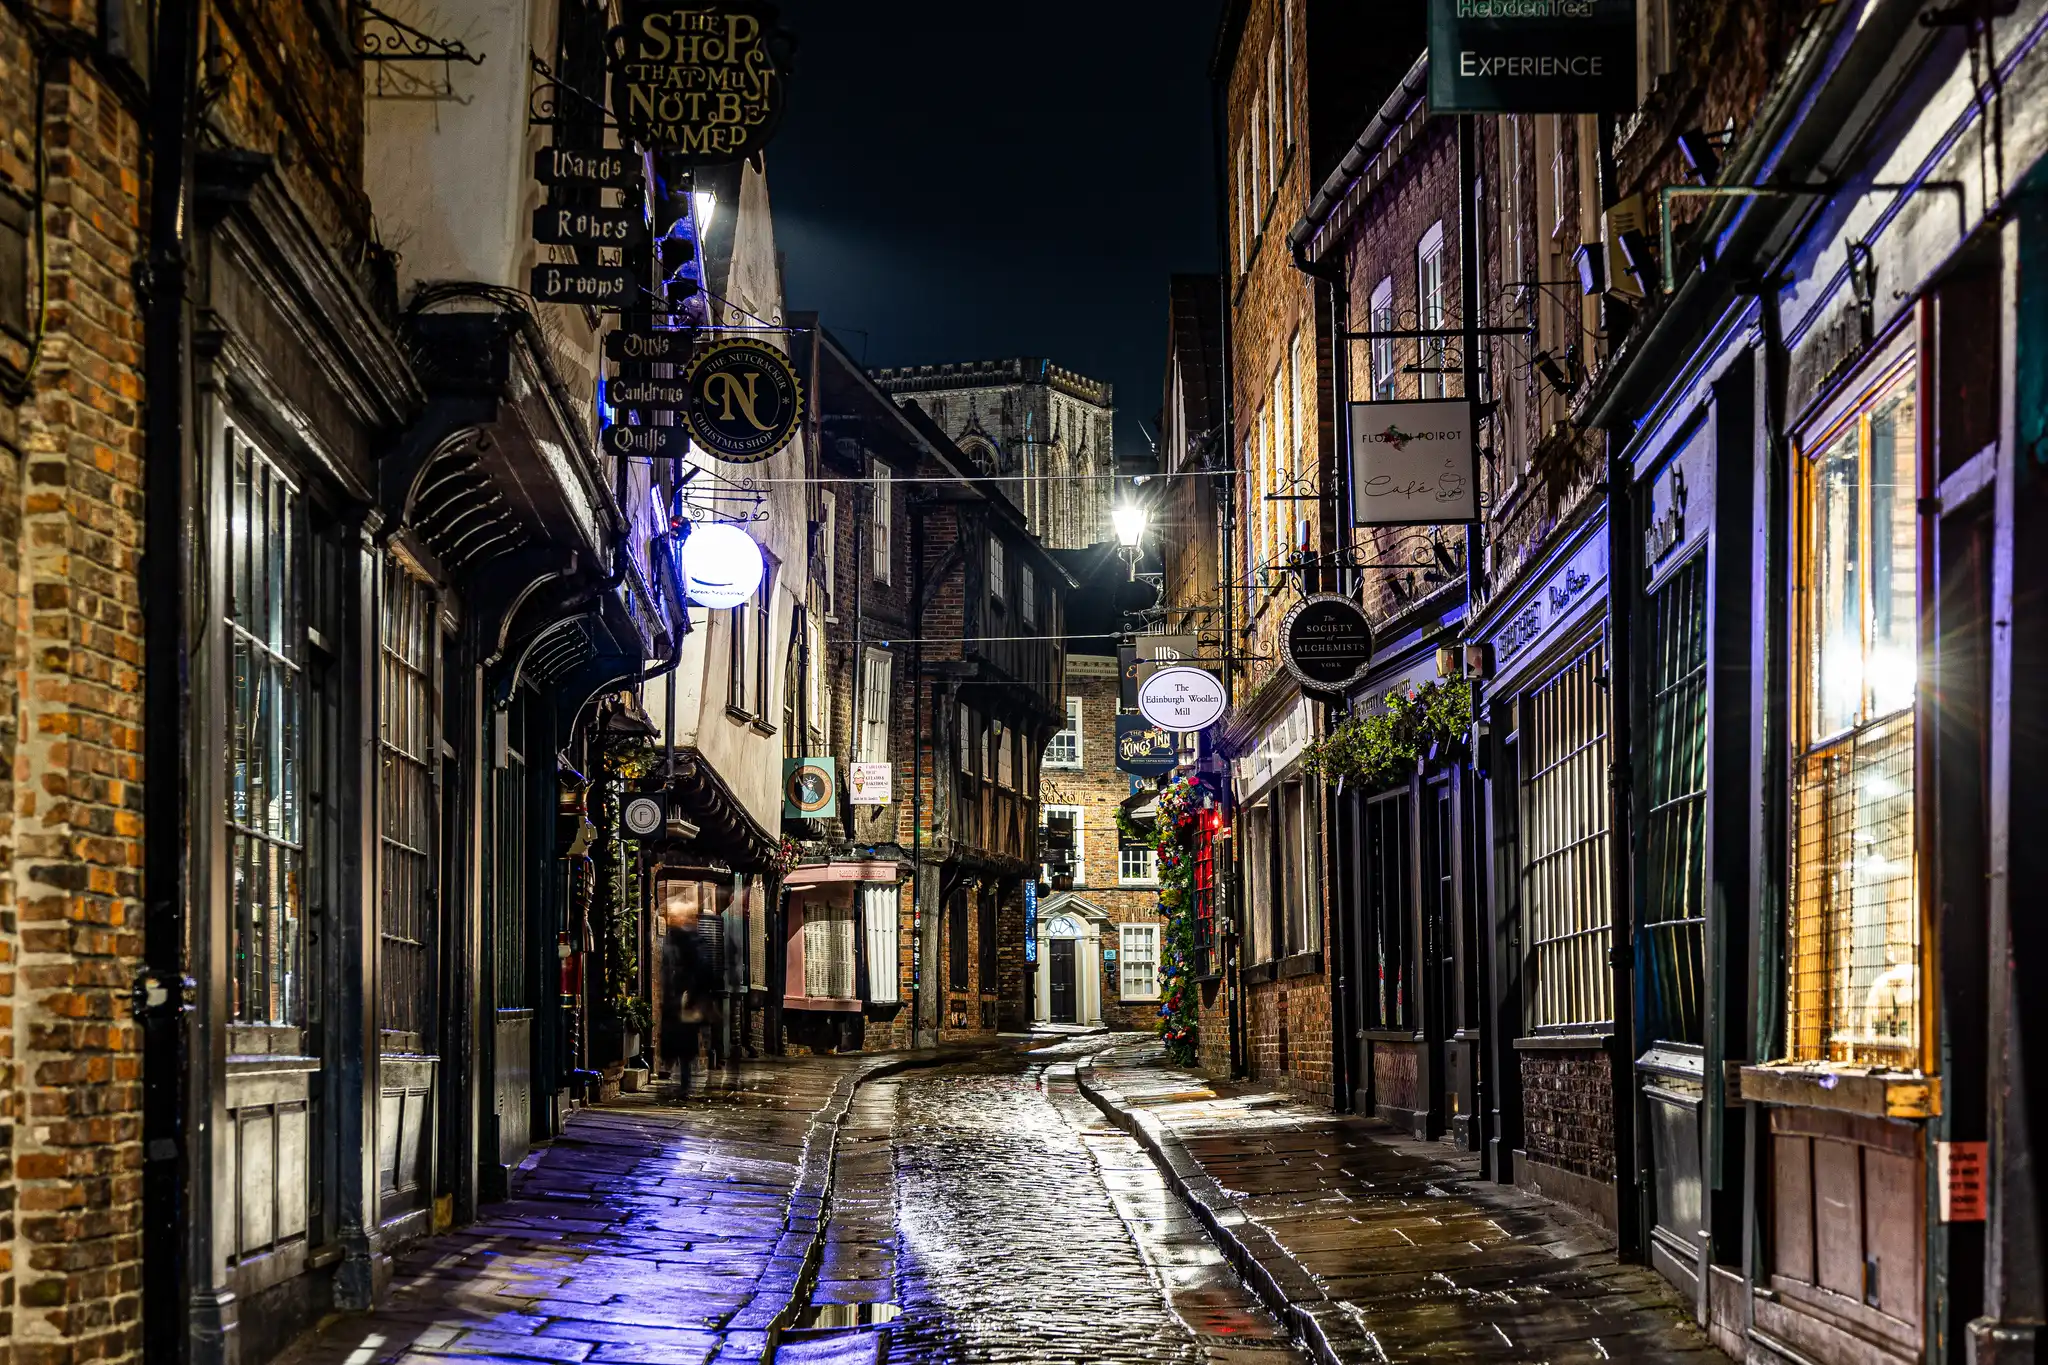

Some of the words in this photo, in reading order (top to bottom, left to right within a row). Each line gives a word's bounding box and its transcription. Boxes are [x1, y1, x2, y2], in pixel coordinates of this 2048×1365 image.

[673, 7, 724, 35] THE
[640, 14, 759, 64] SHOP
[625, 64, 706, 89] THAT
[707, 38, 775, 111] MUST
[1460, 51, 1602, 77] EXPERIENCE
[627, 84, 708, 122] NOT
[716, 93, 766, 125] BE
[646, 112, 747, 154] NAMED
[552, 150, 622, 181] Wands
[557, 210, 629, 239] Robes
[545, 269, 625, 298] Brooms
[623, 333, 669, 357] Owls
[706, 356, 726, 373] THE
[728, 353, 787, 390] NUTCRACKER
[612, 380, 684, 404] Cauldrons
[614, 427, 666, 452] Quills
[694, 412, 744, 450] CHRISTMAS
[746, 431, 774, 449] SHOP
[1417, 431, 1462, 440] POIROT
[1364, 475, 1433, 499] Café
[1306, 624, 1353, 632] SOCIETY
[1297, 643, 1365, 652] ALCHEMISTS
[1145, 695, 1185, 705] Edinburgh
[1188, 694, 1219, 703] Woollen
[1175, 684, 1189, 692] The
[1174, 708, 1191, 716] Mill
[1123, 739, 1151, 757] KINGS
[1154, 733, 1170, 747] INN
